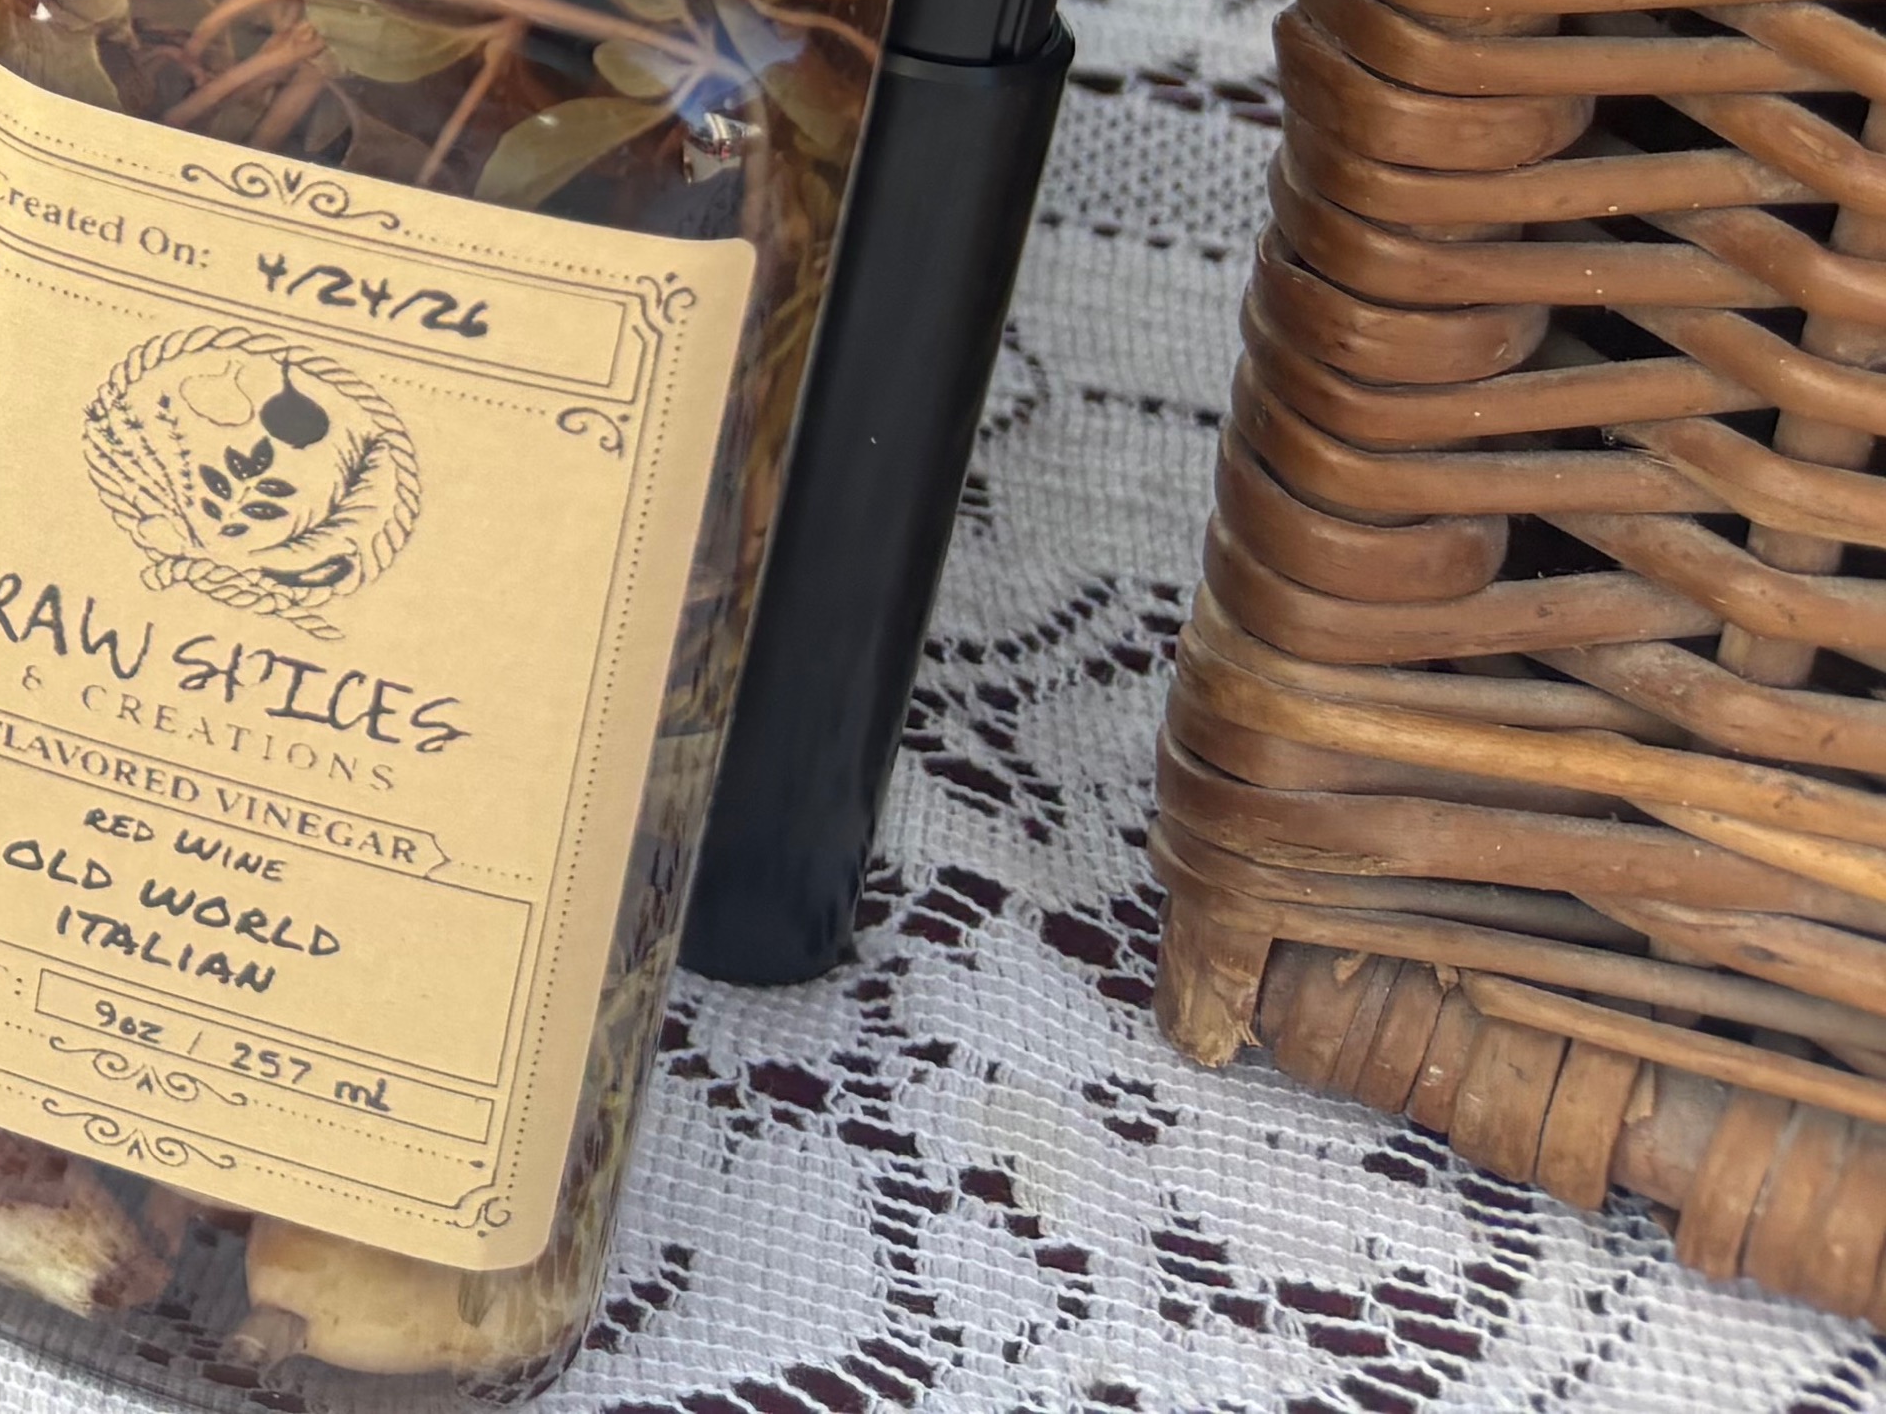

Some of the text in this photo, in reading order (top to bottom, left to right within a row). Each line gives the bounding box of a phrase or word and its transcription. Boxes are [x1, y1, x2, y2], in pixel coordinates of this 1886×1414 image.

[138, 224, 213, 268] On:
[257, 250, 489, 339] 4/24/26
[21, 663, 396, 793] & CREATIONS
[172, 634, 473, 753] SPICES
[83, 808, 288, 883] RED WINE
[215, 787, 418, 866] VINEGAR
[2, 838, 342, 958] OLD WORLD
[56, 905, 277, 995] ITALIAN
[230, 1042, 312, 1085] 257
